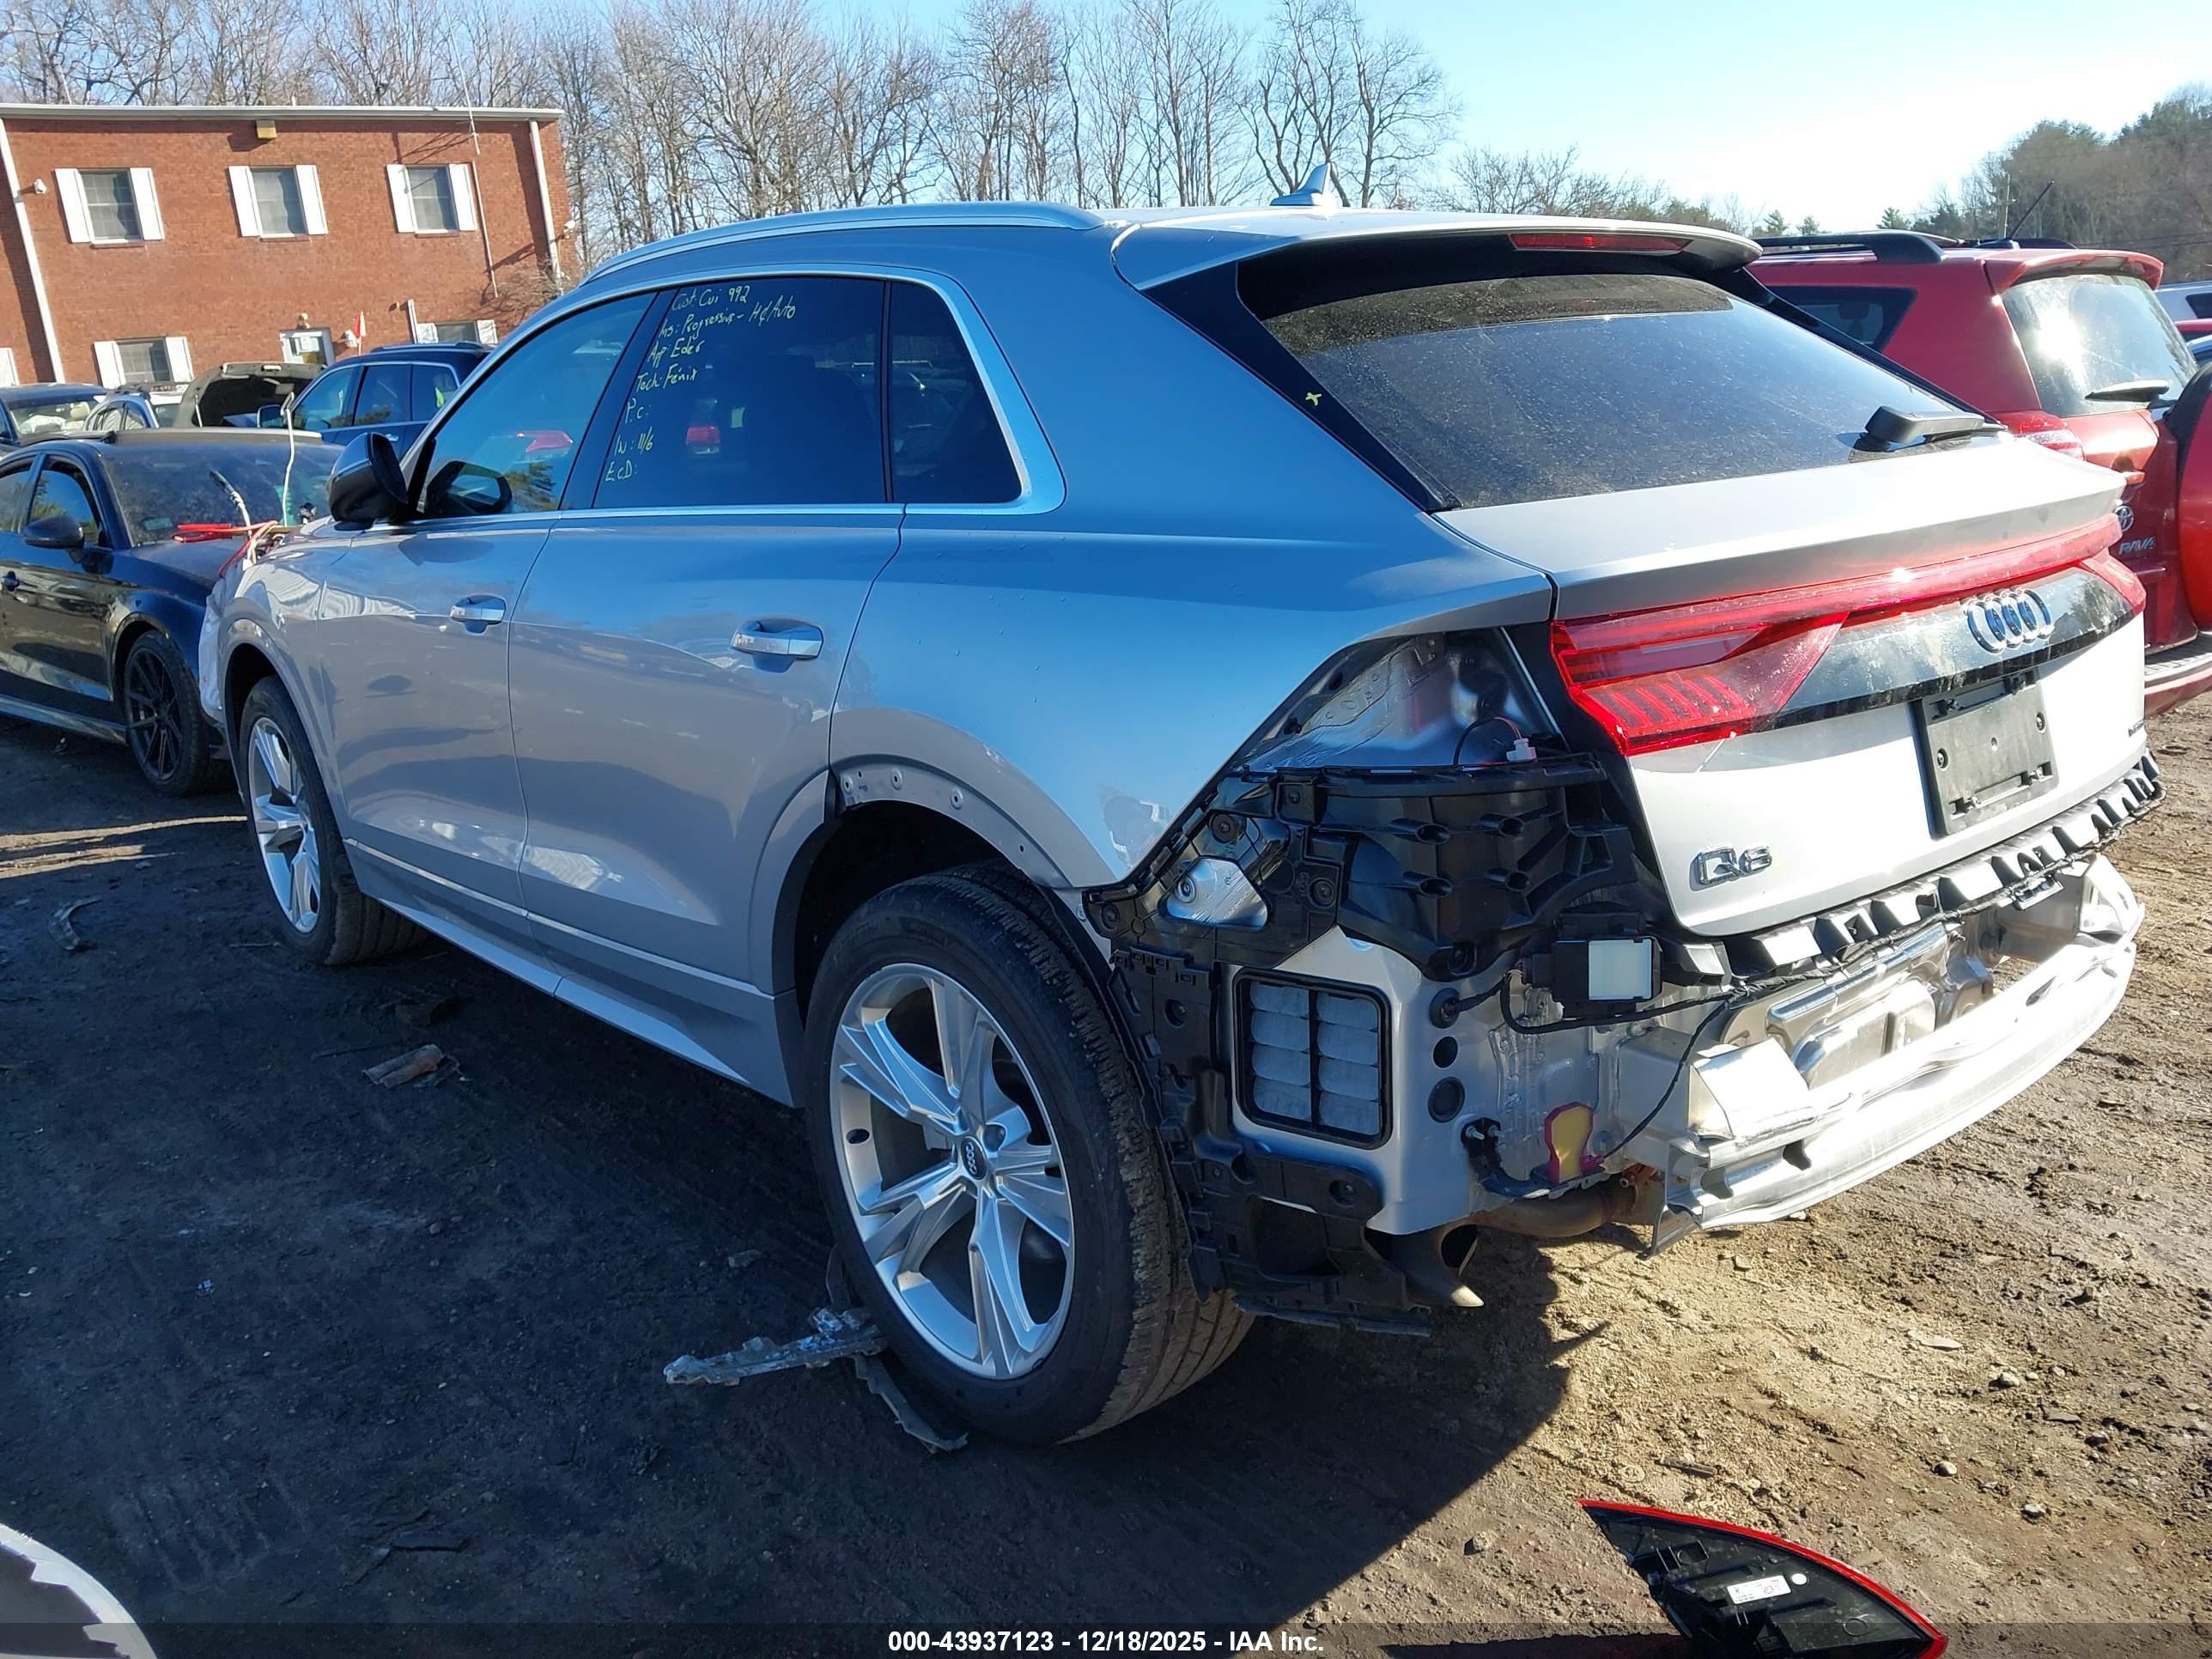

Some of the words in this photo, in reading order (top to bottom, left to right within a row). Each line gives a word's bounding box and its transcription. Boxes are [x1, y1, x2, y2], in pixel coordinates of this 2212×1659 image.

[728, 285, 751, 303] 992
[637, 426, 655, 454] 11/6
[1689, 846, 1773, 892] Q8
